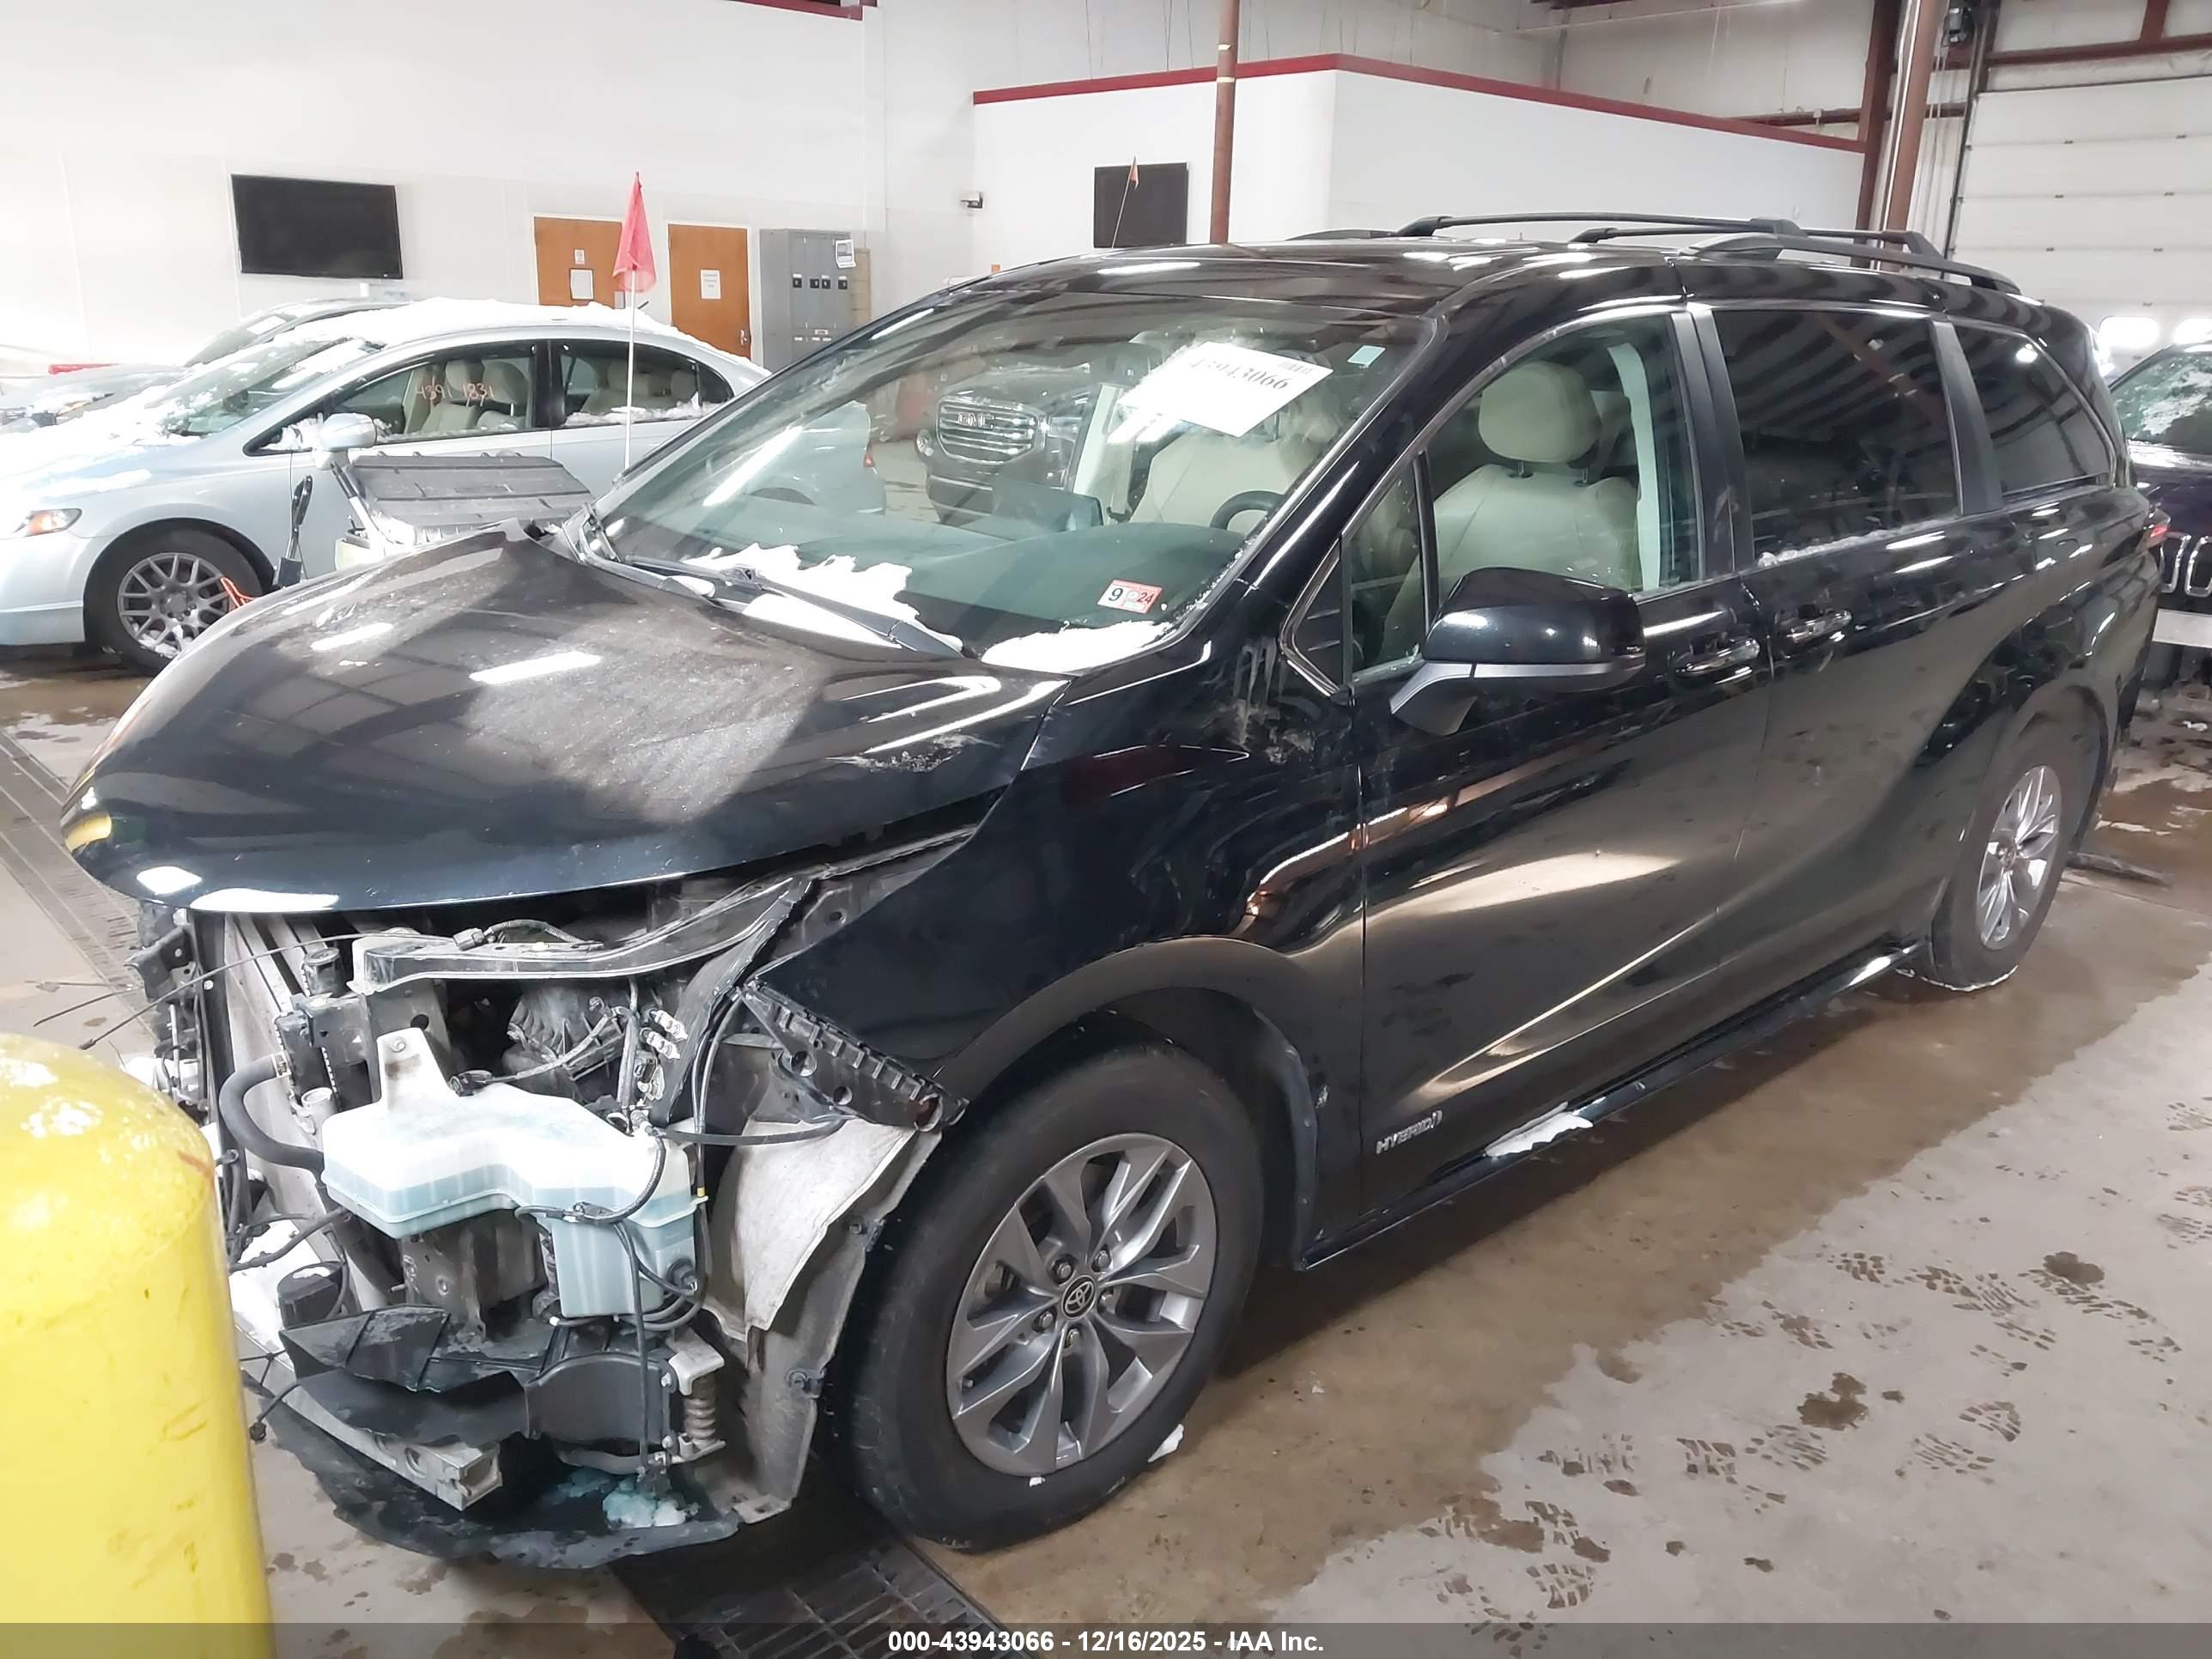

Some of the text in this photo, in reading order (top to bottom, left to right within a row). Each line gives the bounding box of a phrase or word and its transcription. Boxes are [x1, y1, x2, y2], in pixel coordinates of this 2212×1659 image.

[463, 383, 495, 400] 1831
[957, 412, 994, 429] GMC
[1108, 587, 1155, 604] 9 24
[1376, 1115, 1434, 1154] HYBRID
